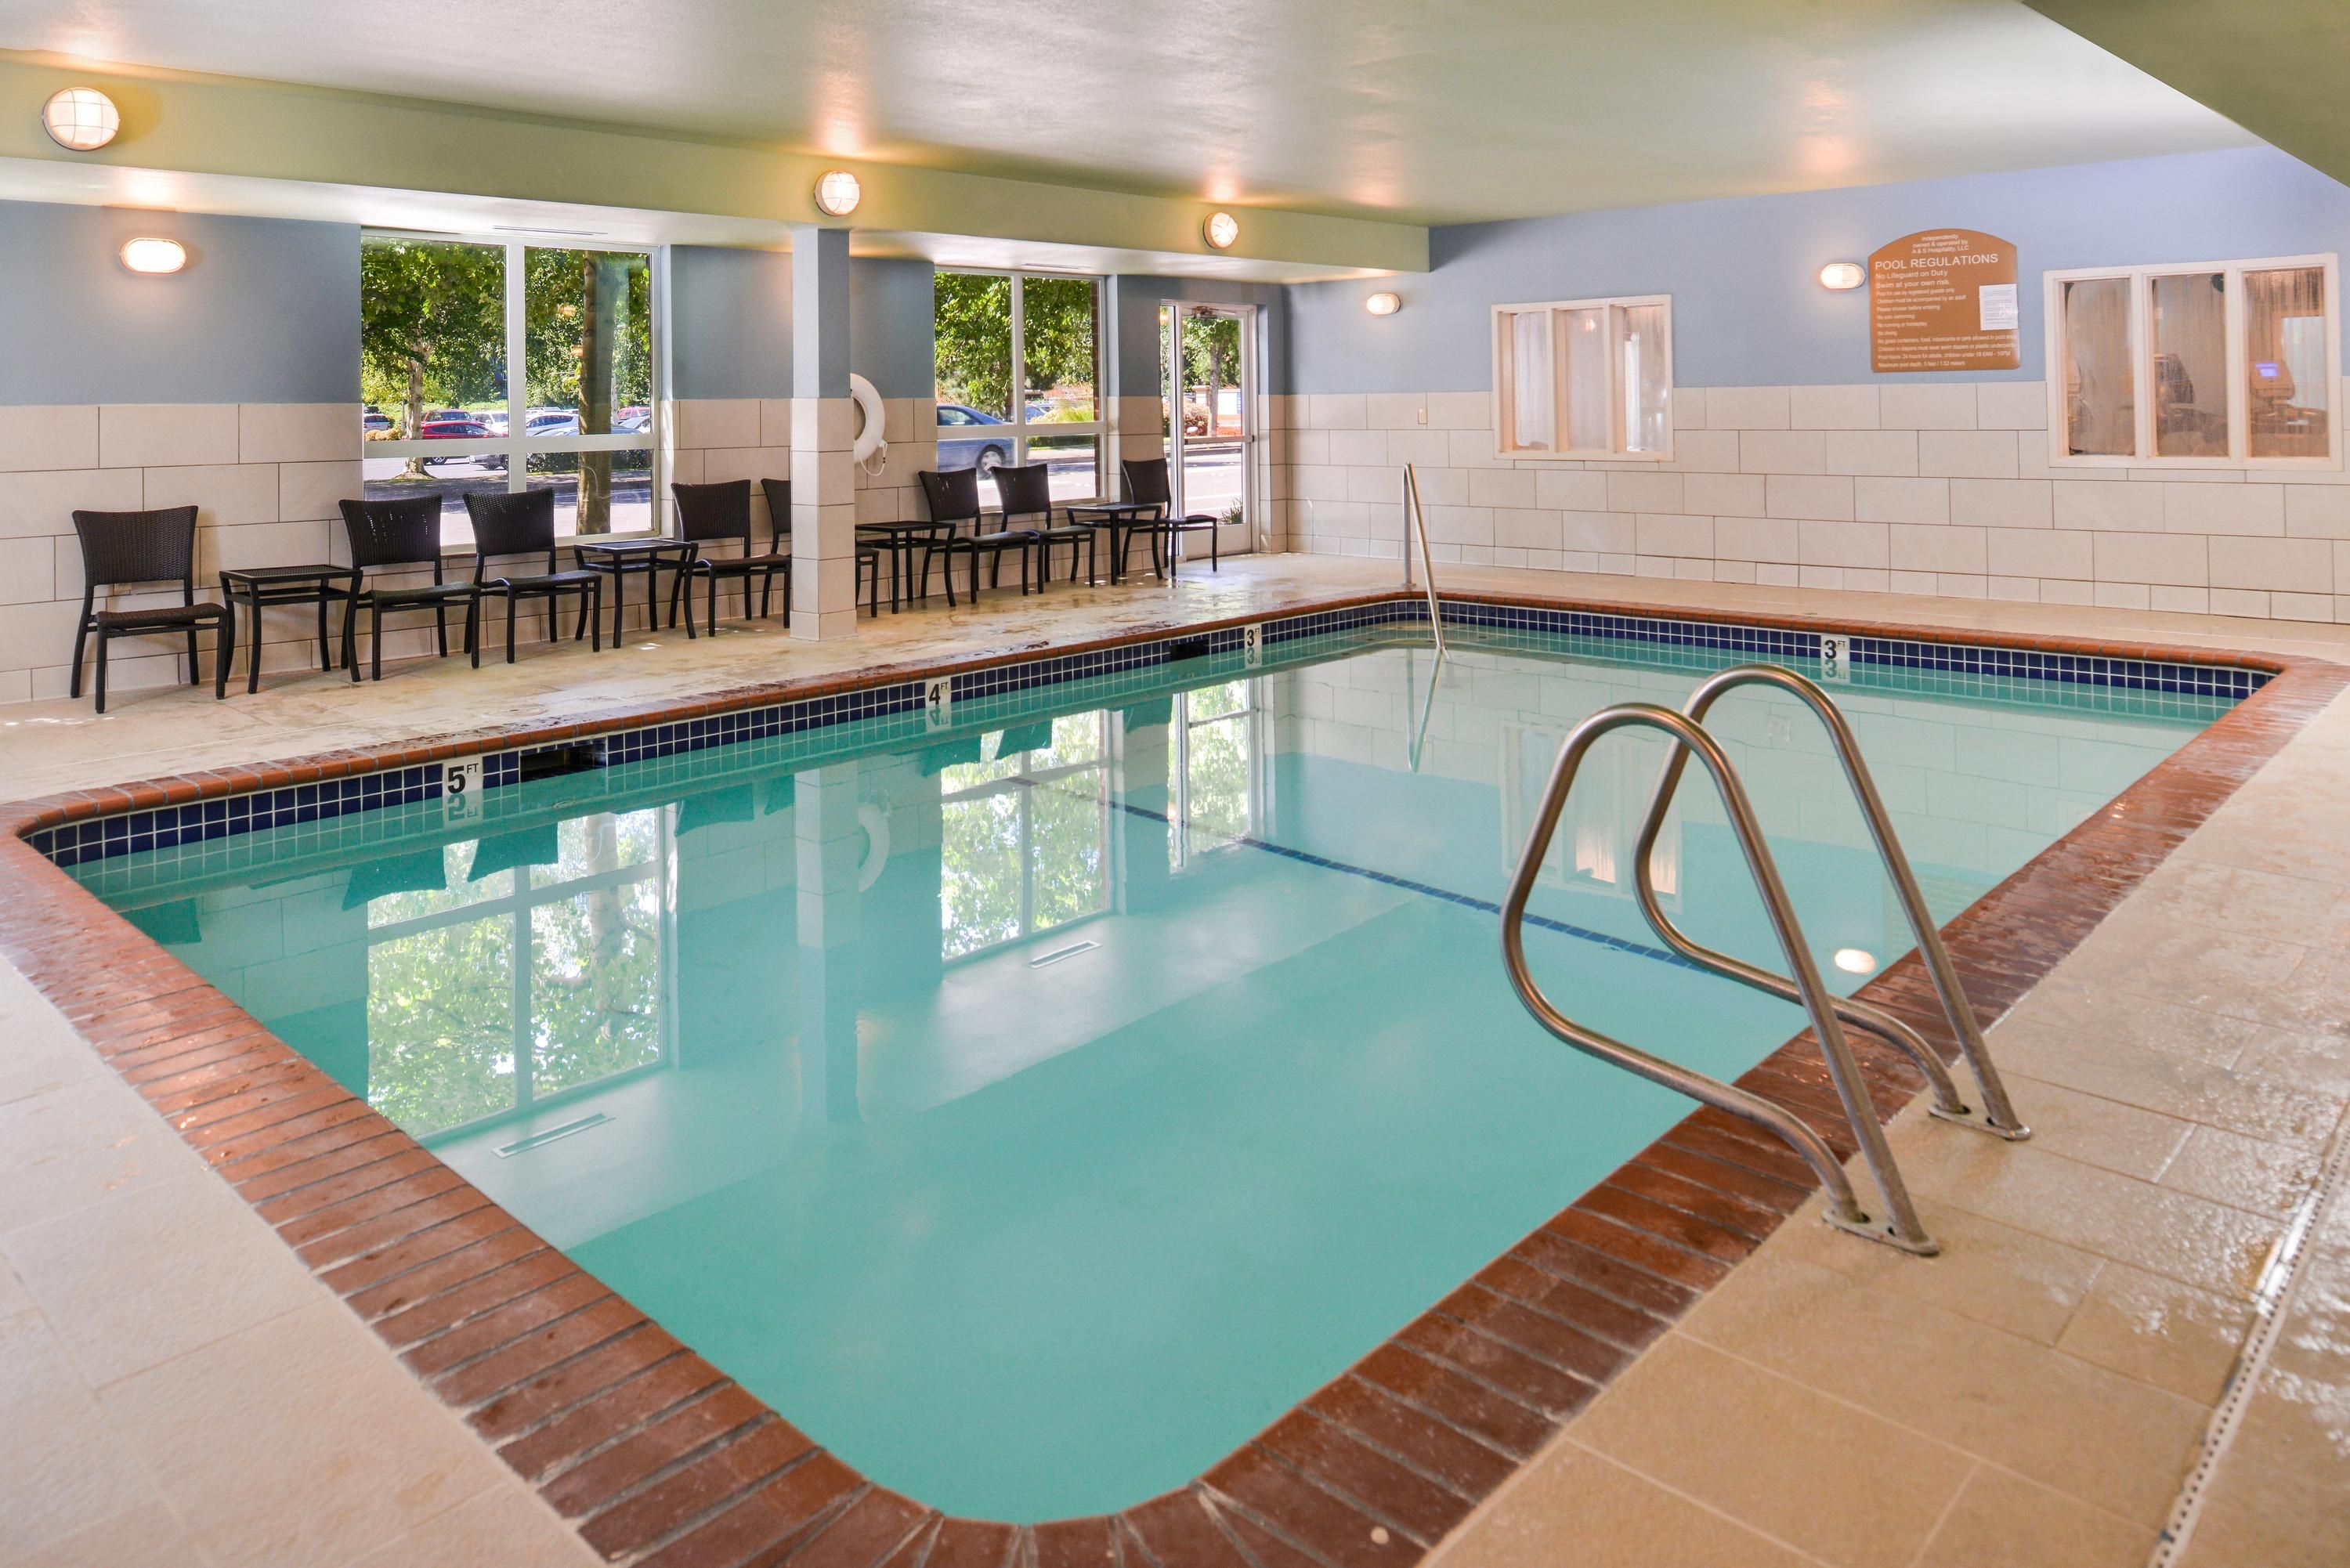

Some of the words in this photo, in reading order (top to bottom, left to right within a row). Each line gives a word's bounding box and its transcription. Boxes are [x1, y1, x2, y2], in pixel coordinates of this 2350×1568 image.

[1875, 260, 1907, 270] POOL
[1911, 253, 1998, 268] REGULATIONS
[1247, 629, 1254, 646] 3
[1824, 639, 1837, 659] 3
[929, 684, 940, 705] 4
[941, 682, 948, 691] FT
[448, 765, 466, 794] 5
[467, 763, 478, 774] FT
